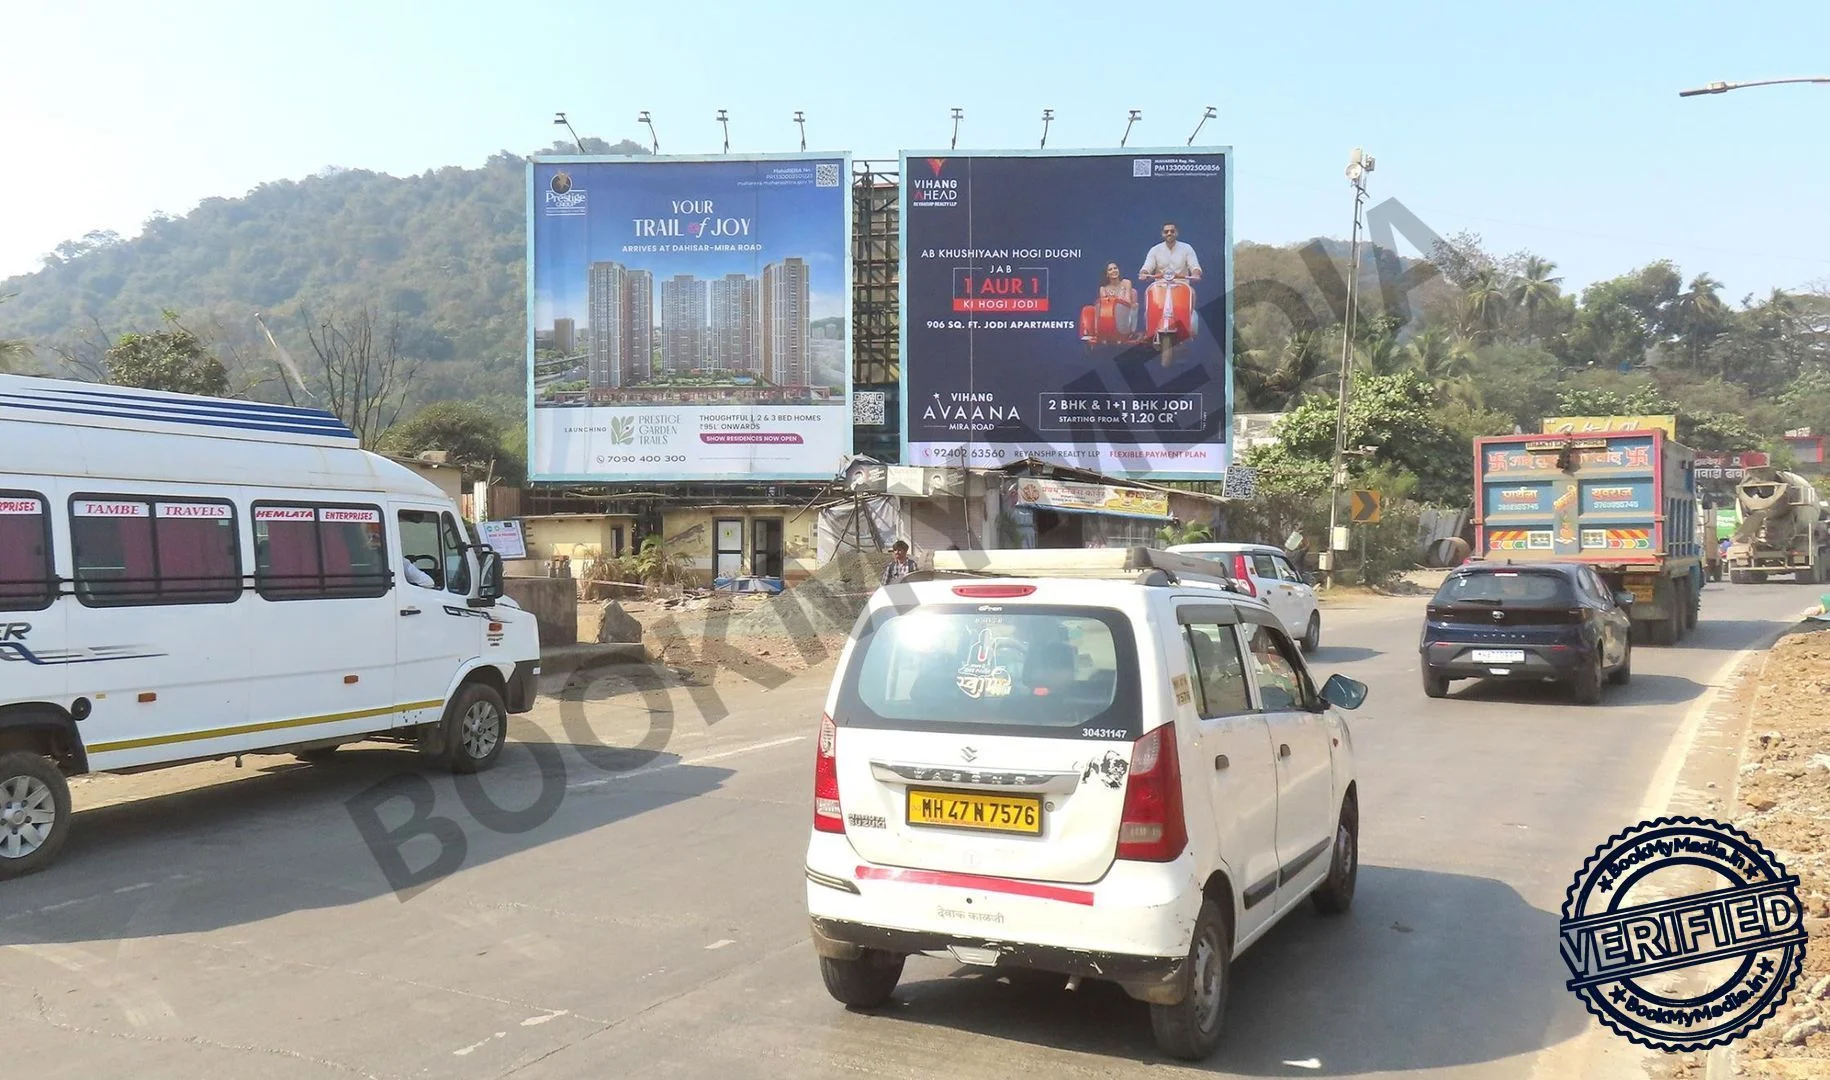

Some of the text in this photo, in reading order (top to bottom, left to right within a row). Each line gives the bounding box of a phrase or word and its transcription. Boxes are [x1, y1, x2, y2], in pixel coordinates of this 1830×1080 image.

[914, 179, 957, 189] VIHANG
[545, 192, 586, 204] Prestige
[914, 190, 957, 200] AHEAD
[672, 200, 713, 214] YOUR
[632, 219, 684, 237] TRAIL
[710, 218, 751, 236] JOY
[672, 244, 735, 252] DAHISAR-MIRA
[921, 249, 1081, 258] AB KHUSHIYAAN HOGI DUGNI
[990, 265, 1012, 274] JAB
[963, 278, 1039, 294] 1 AUR 1
[963, 300, 1038, 309] KI HOGI JODI
[926, 321, 1075, 330] 906 SQ. FT. JODI APARTMENTS
[951, 393, 994, 402] VIHANG
[923, 399, 1021, 420] AVAANA
[1048, 399, 1193, 411] 2 BHK & 1+1 BHK JODI
[638, 414, 681, 424] PRESTIGE
[638, 425, 678, 435] GARDEN
[949, 423, 995, 431] MIRA ROAD
[639, 435, 668, 445] TRAILS
[933, 449, 1006, 458] 92402 63560
[607, 455, 636, 463] 7090
[86, 504, 225, 516] TAMBE TRAVELS
[256, 510, 373, 520] HEMLATA ENTERPRISES
[1082, 729, 1127, 738] 30431147
[922, 799, 943, 818] MH
[948, 801, 969, 819] 47
[974, 803, 984, 822] N
[990, 804, 1035, 825] 7576
[849, 819, 887, 829] SUZUKI
